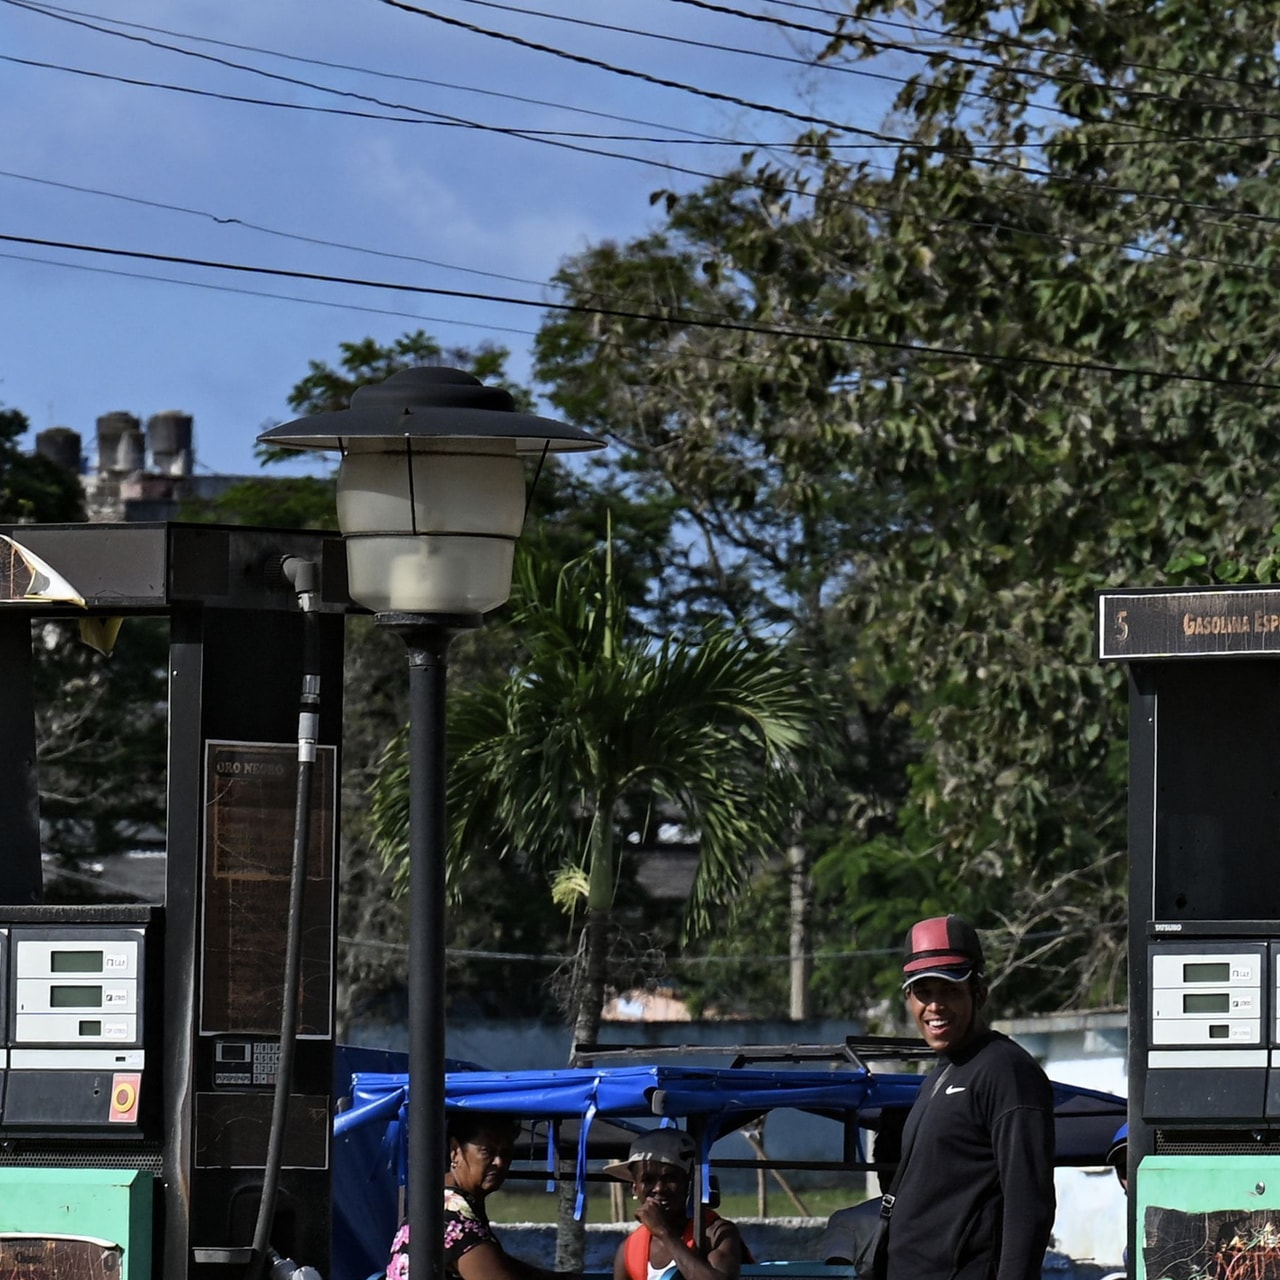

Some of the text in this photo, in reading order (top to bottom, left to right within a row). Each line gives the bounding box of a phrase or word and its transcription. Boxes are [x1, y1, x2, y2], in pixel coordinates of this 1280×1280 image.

[1114, 610, 1129, 641] 5
[1183, 612, 1250, 635] GASOLINA
[216, 761, 241, 774] ORO
